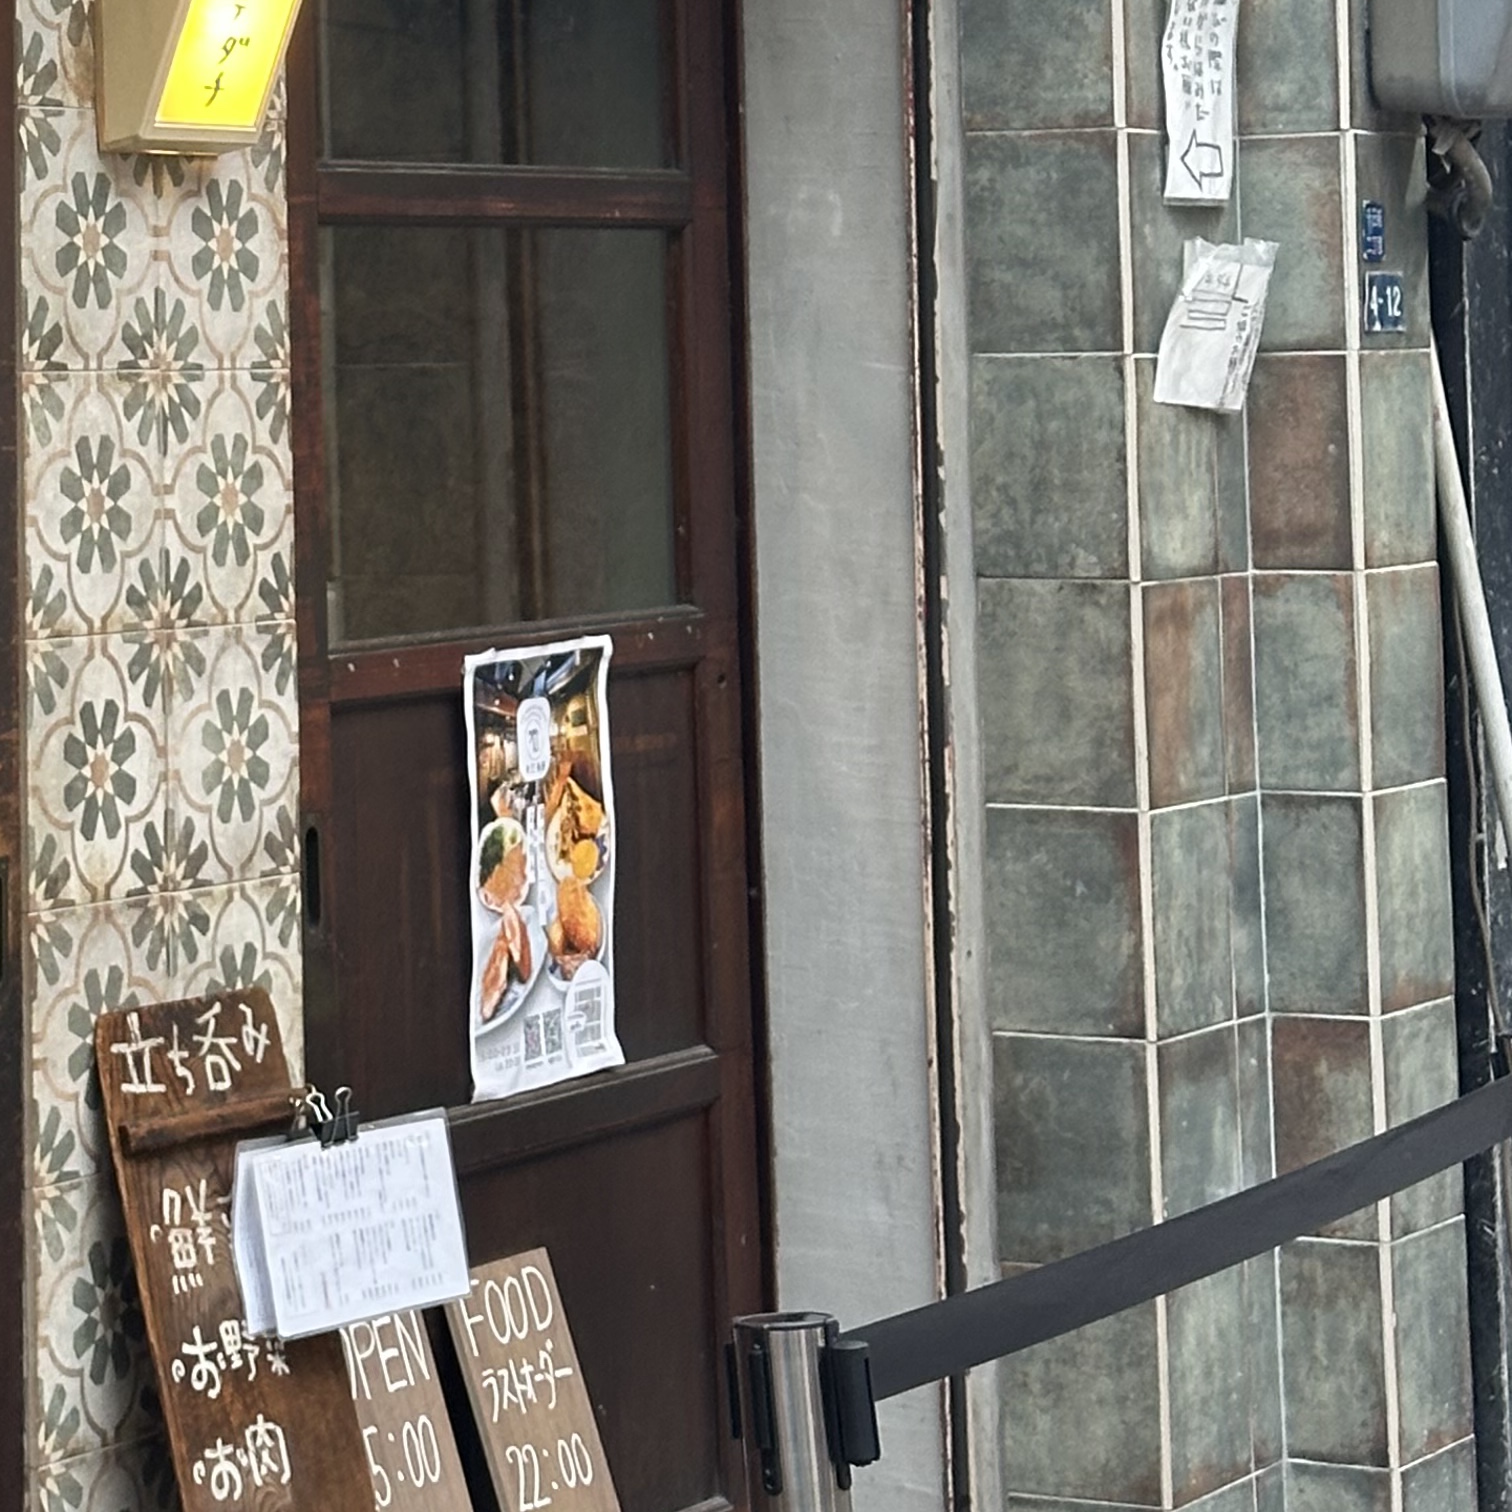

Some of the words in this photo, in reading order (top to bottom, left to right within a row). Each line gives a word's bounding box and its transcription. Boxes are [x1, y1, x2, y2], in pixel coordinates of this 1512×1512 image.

[110, 1001, 272, 1095] 立ち呑み
[456, 1265, 554, 1357] FOOD
[203, 1413, 292, 1502] お肉
[505, 1432, 594, 1512] 22:00
